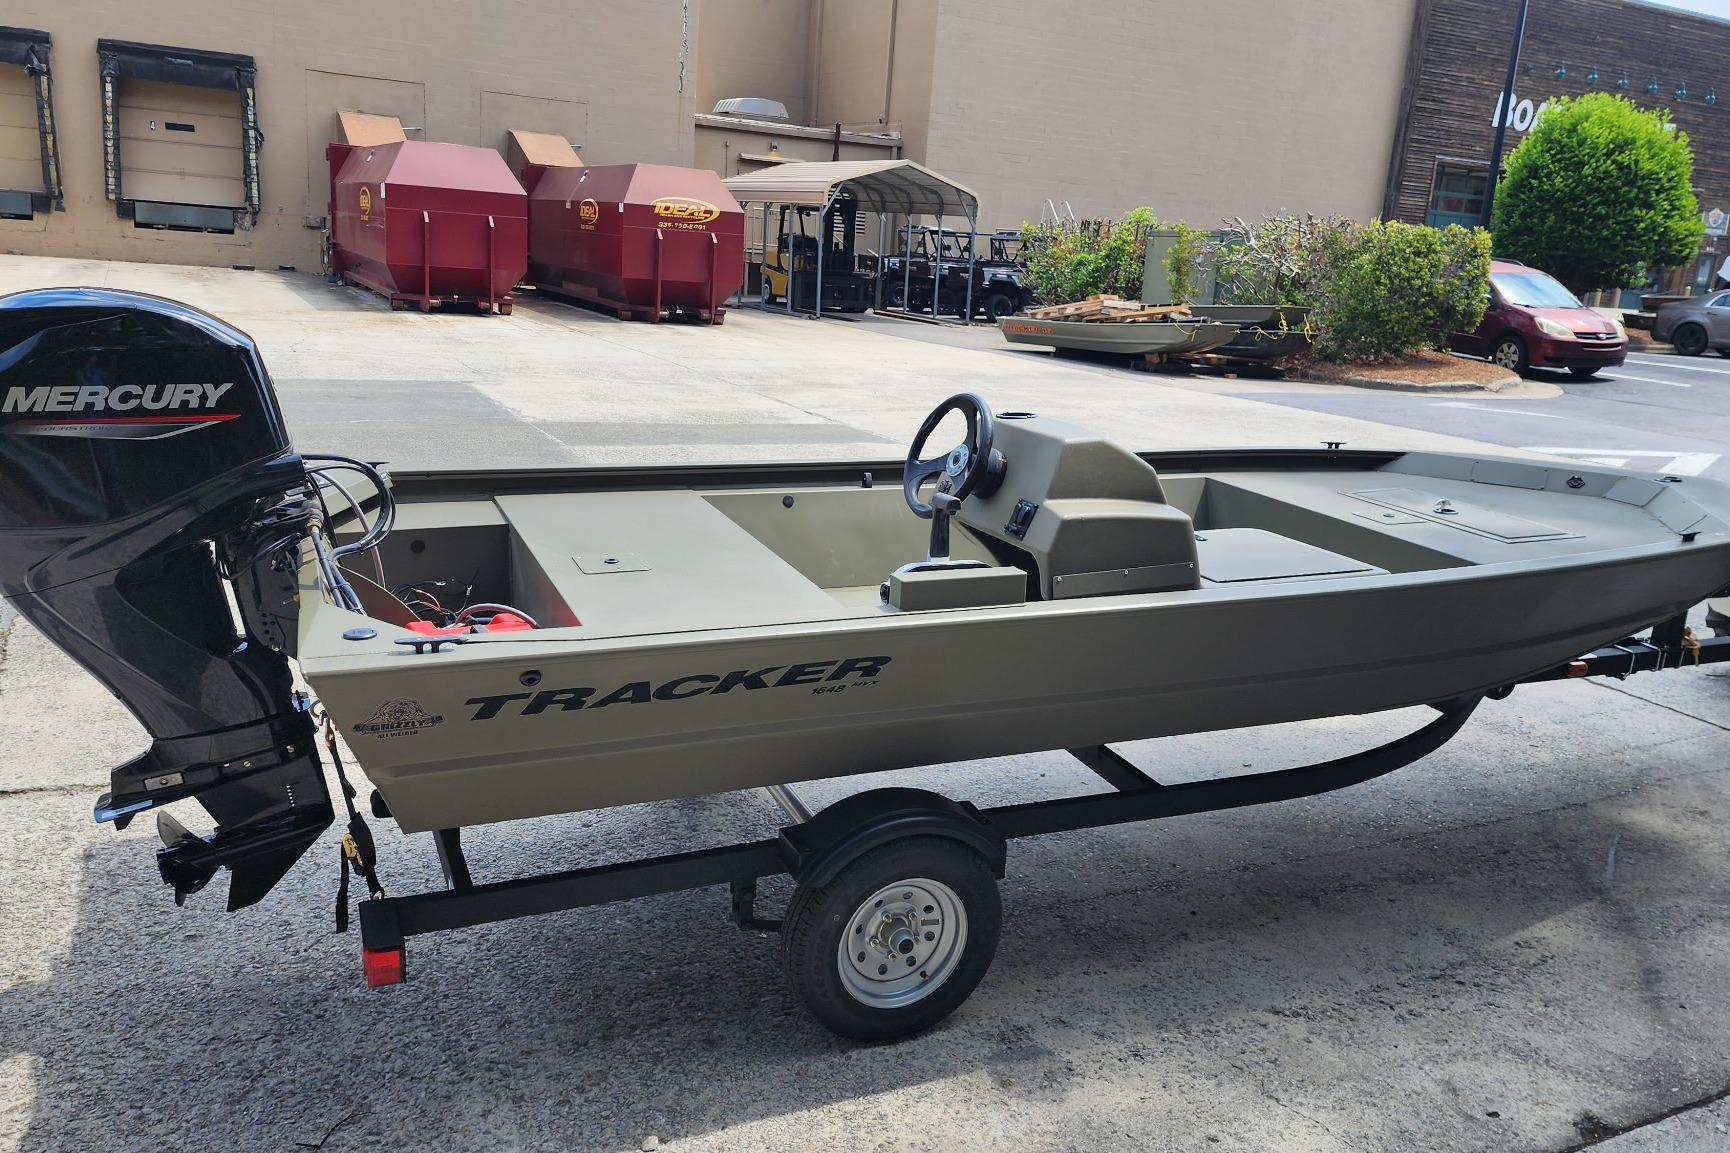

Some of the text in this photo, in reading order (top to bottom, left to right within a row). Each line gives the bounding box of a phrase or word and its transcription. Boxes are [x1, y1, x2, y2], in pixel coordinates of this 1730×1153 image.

[150, 120, 155, 130] 4
[654, 202, 711, 217] IDEAL
[1, 382, 234, 413] MERCURY
[465, 656, 892, 720] TRACKER
[811, 680, 880, 695] 1648 MVX
[370, 720, 425, 731] GRIZZLY
